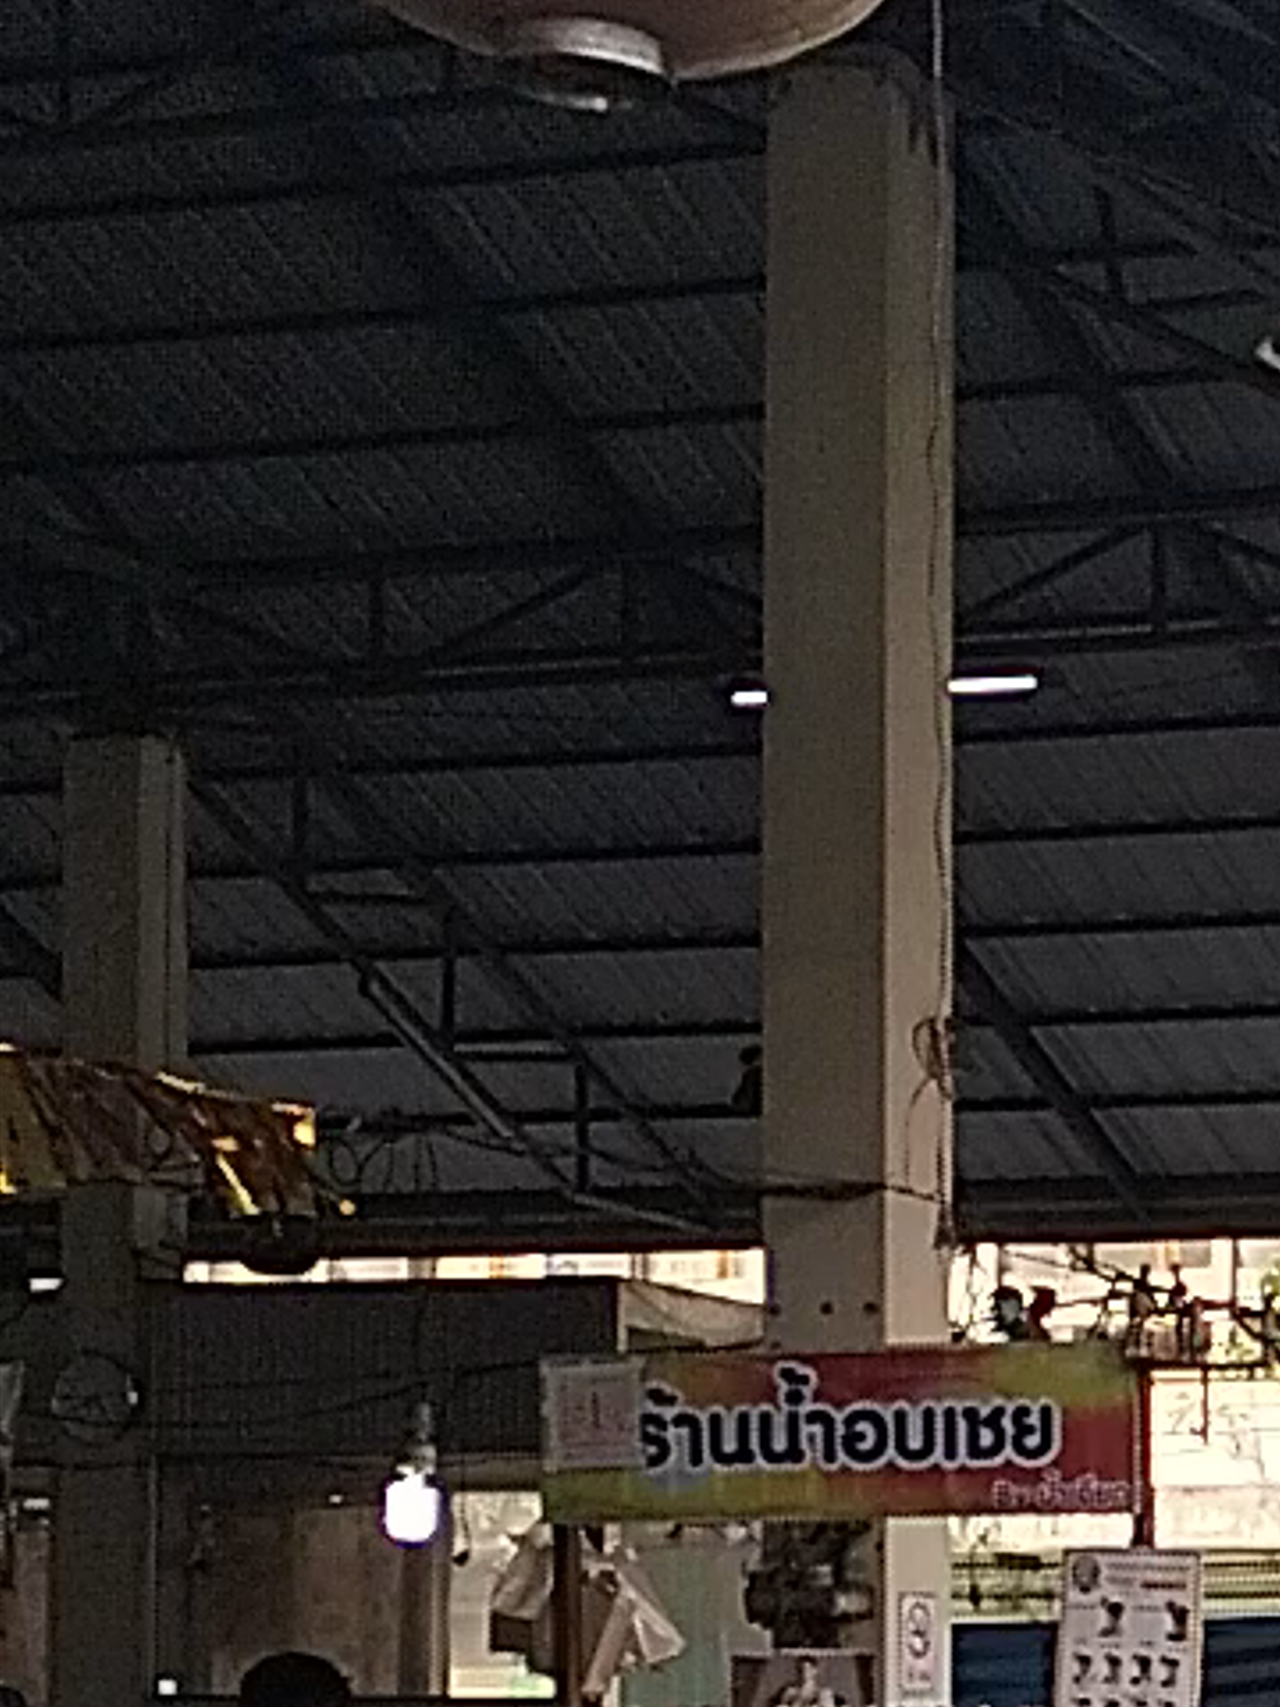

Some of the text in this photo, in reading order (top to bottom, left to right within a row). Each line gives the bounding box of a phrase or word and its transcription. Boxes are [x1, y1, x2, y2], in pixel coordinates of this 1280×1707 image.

[640, 1363, 1053, 1466] ร้านน้ำอบเชย
